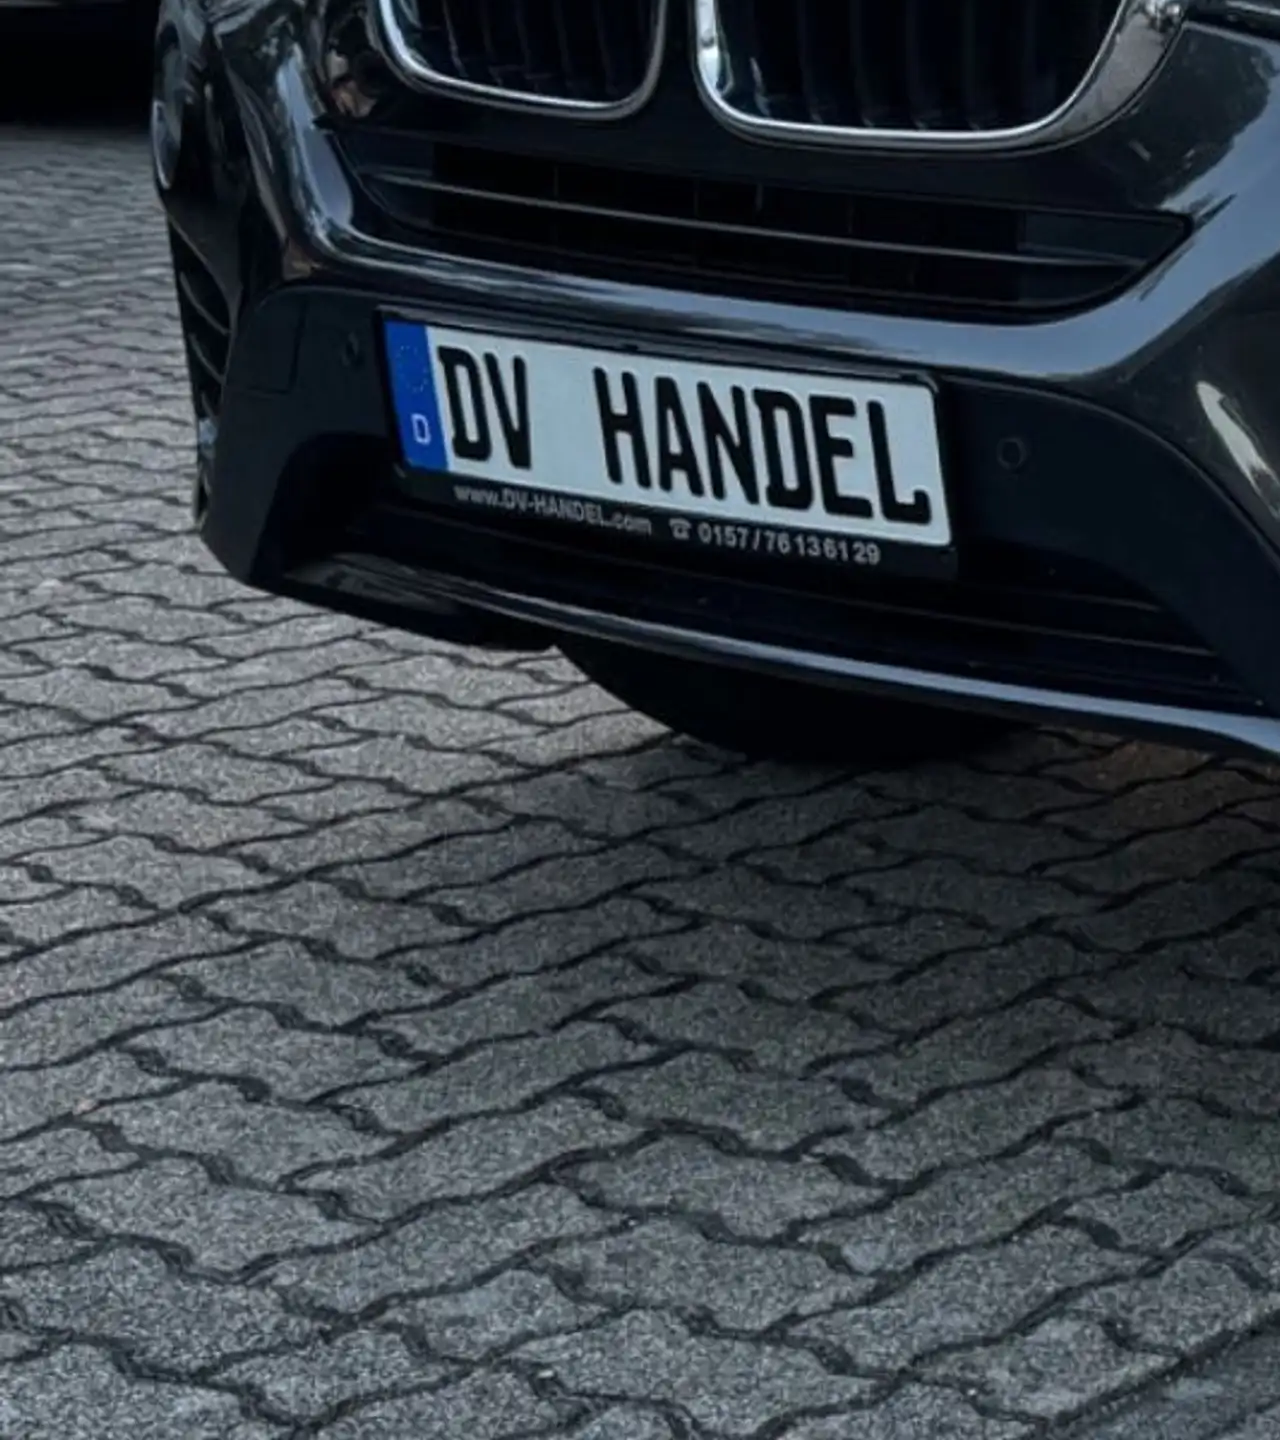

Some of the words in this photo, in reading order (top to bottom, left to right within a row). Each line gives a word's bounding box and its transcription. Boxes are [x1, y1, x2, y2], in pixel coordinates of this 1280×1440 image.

[411, 414, 432, 446] D
[437, 345, 532, 470] DV
[593, 366, 932, 526] HANDEL
[453, 484, 652, 536] www.DV-HANDEL.com
